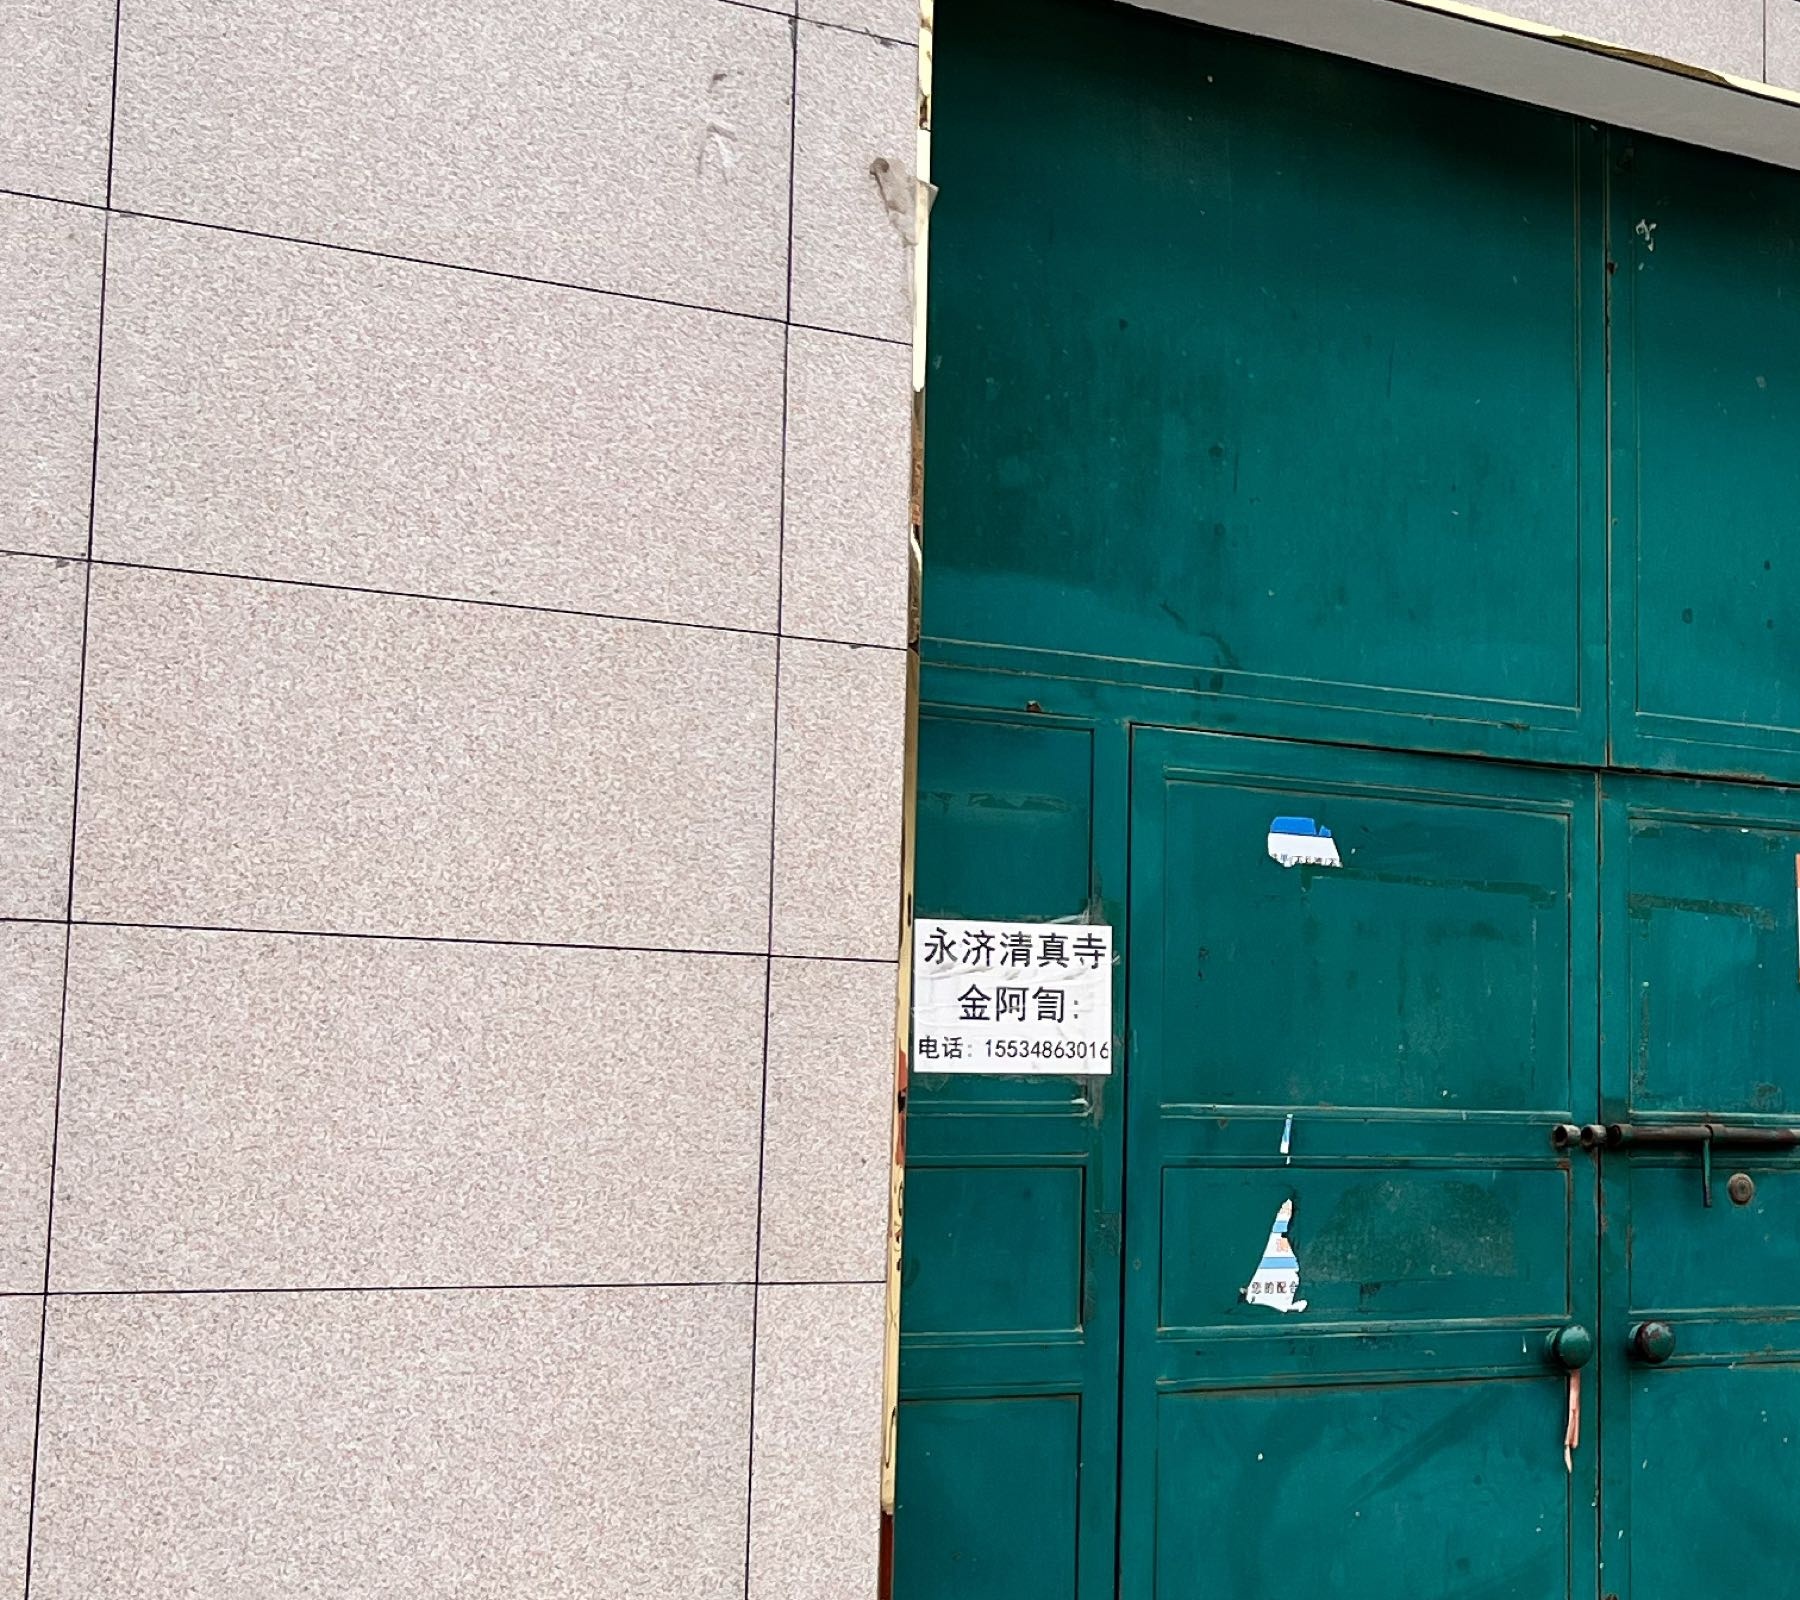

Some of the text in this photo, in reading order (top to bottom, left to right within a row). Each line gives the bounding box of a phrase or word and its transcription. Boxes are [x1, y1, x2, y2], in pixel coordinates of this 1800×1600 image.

[924, 926, 1107, 970] 永济清真寺
